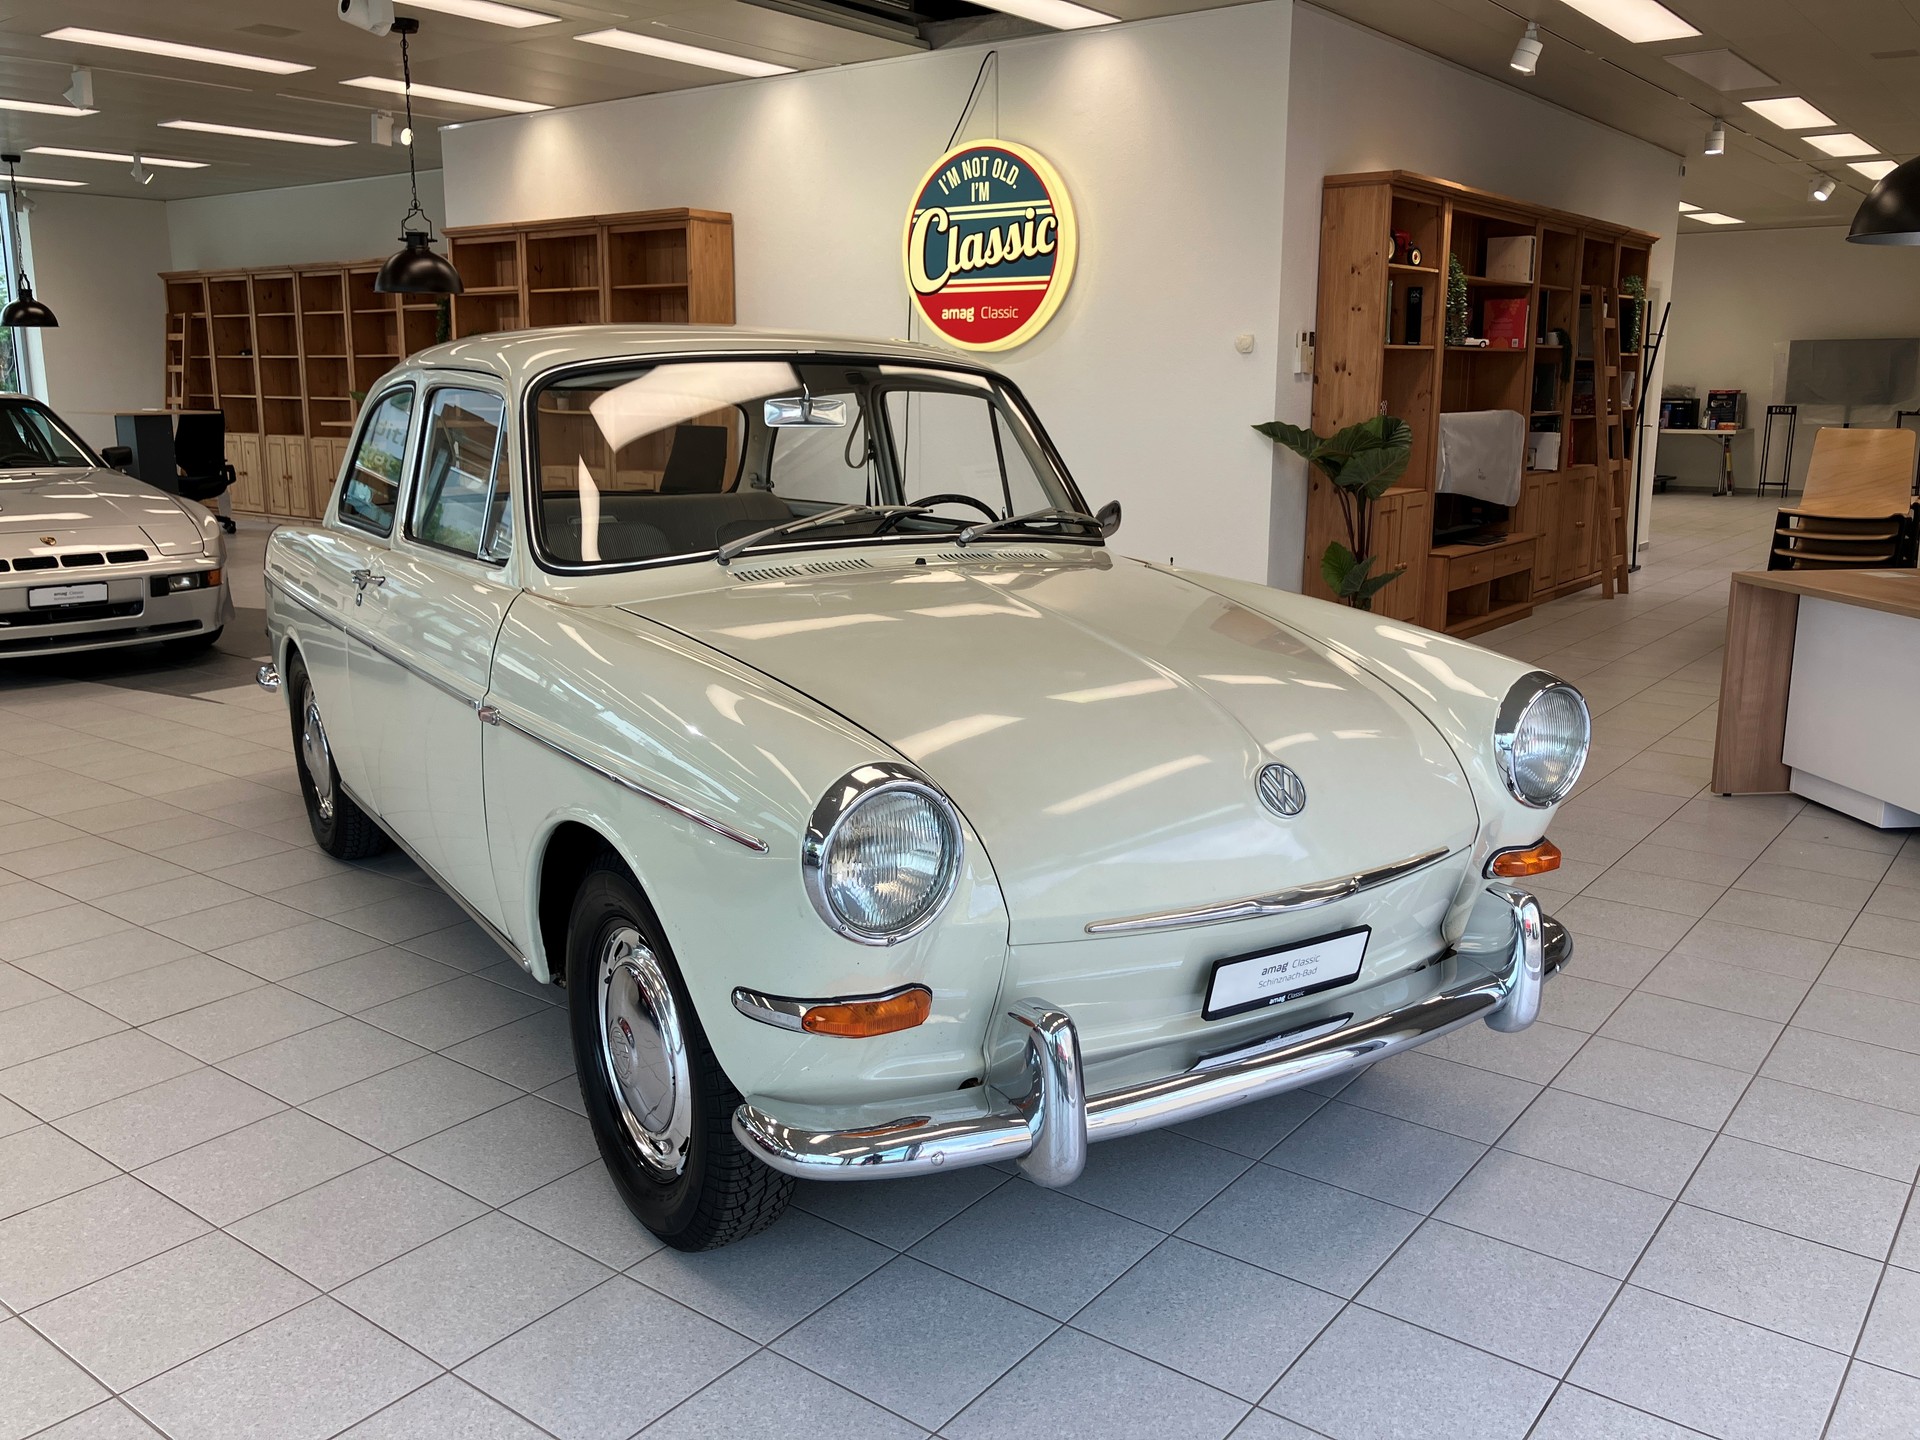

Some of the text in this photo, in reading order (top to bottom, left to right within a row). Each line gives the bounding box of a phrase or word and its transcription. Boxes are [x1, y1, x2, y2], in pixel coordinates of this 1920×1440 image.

[938, 156, 1020, 195] I'M NOT OLD.
[971, 181, 990, 203] I'M
[909, 206, 1059, 296] Classic
[941, 305, 1019, 323] amag Classic
[1258, 763, 1306, 816] VW
[1261, 955, 1320, 976] amag Classic
[1258, 967, 1318, 989] Schinznach-Bad
[1269, 994, 1286, 1004] amag
